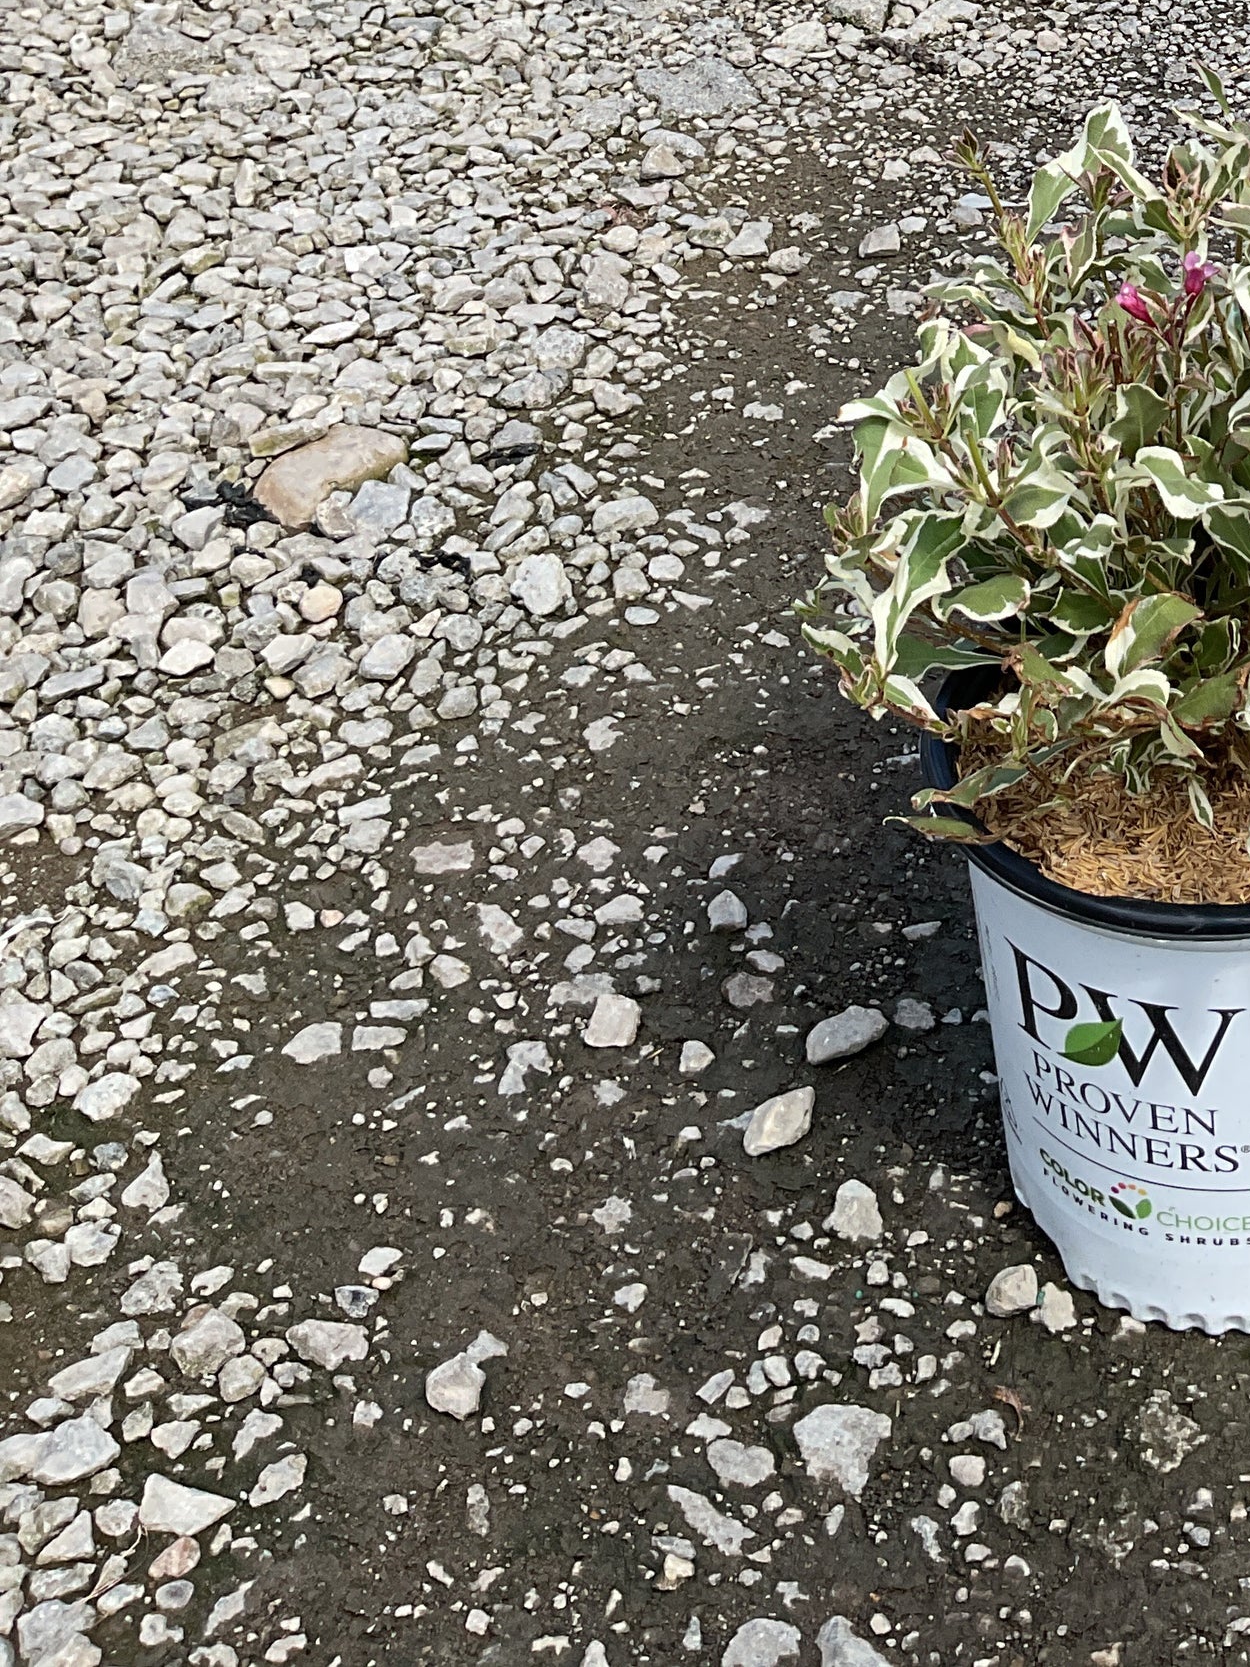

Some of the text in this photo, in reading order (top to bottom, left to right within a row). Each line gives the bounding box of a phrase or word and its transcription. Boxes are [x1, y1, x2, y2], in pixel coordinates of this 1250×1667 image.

[1003, 935, 1248, 1097] PW
[1031, 1048, 1219, 1137] PROVEN
[1039, 1147, 1106, 1207] COLOR
[1043, 1167, 1149, 1237] FLOWERING
